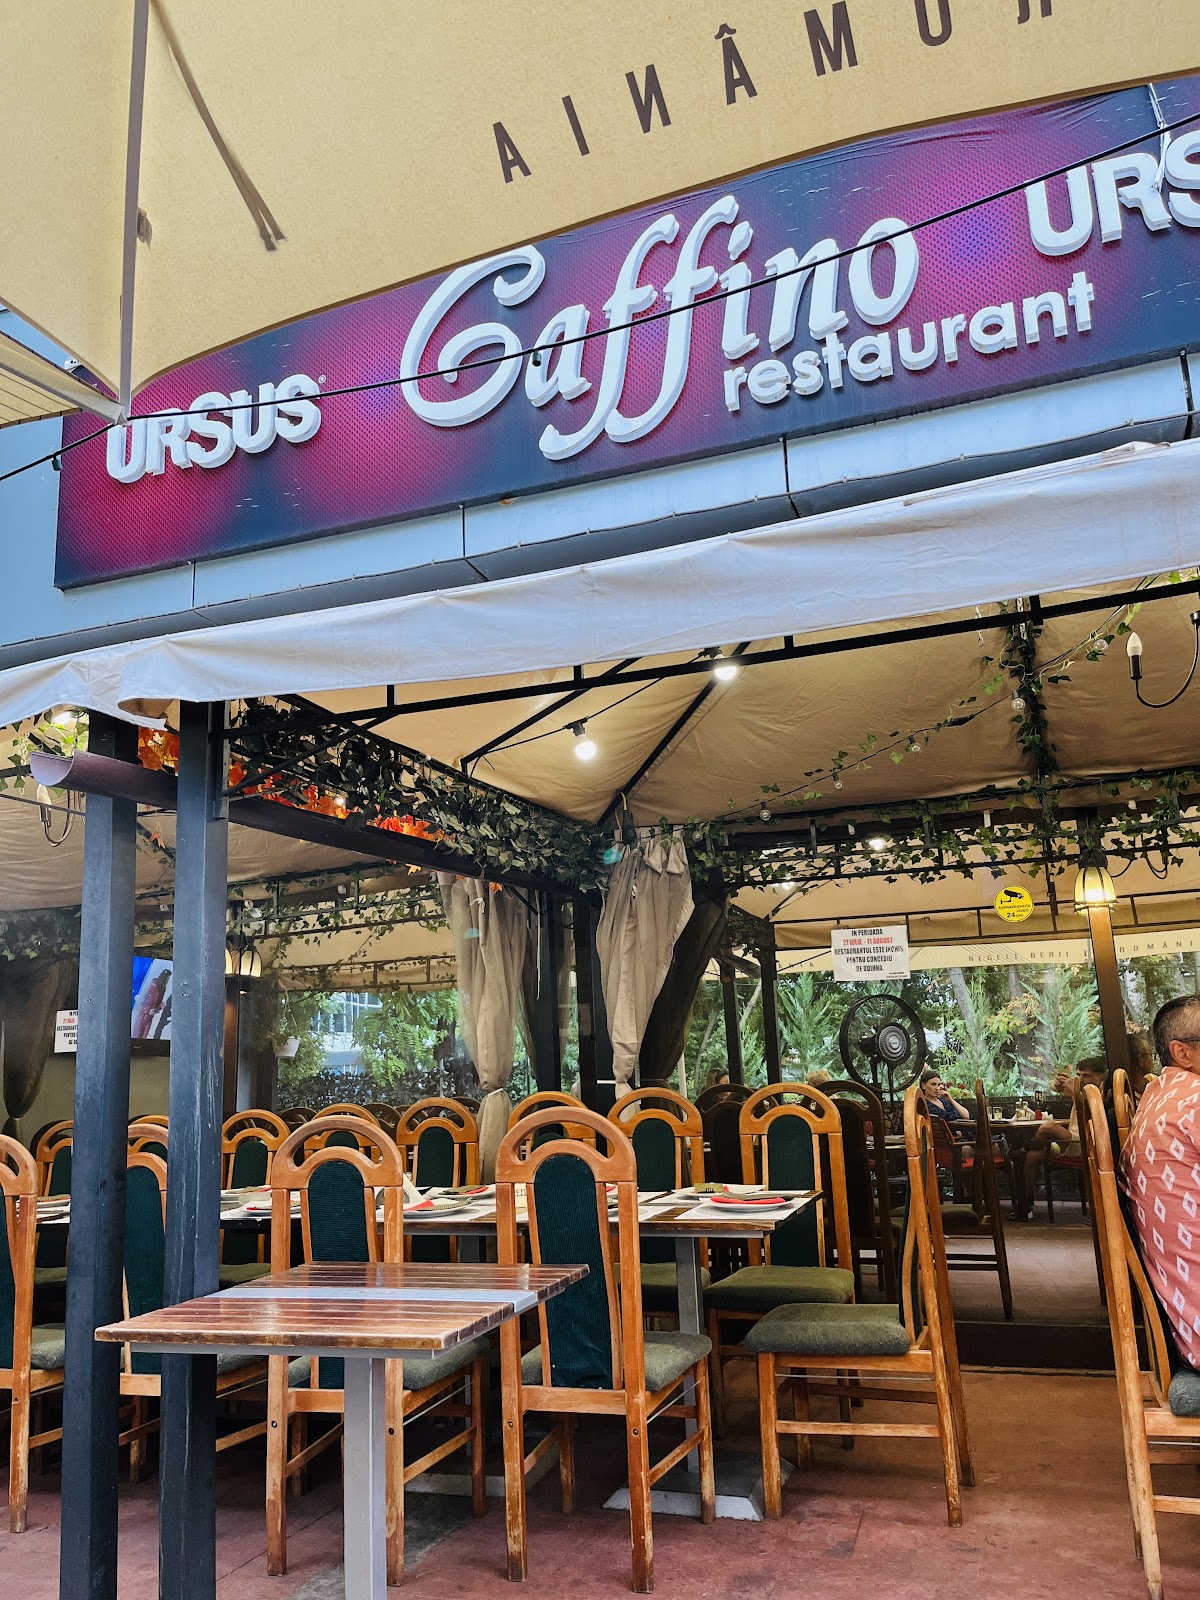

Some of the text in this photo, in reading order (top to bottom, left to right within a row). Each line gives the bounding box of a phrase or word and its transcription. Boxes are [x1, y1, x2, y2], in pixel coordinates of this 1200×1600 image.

[723, 271, 1095, 412] restaurant
[106, 373, 322, 484] URSUS
[858, 928, 883, 936] PERIOADA
[849, 938, 862, 946] IULIE
[872, 937, 893, 945] AUGUST
[834, 947, 872, 956] RESTAURANTUL
[873, 946, 885, 954] ESTE
[866, 955, 893, 963] CONCEDIU
[855, 965, 862, 973] DE
